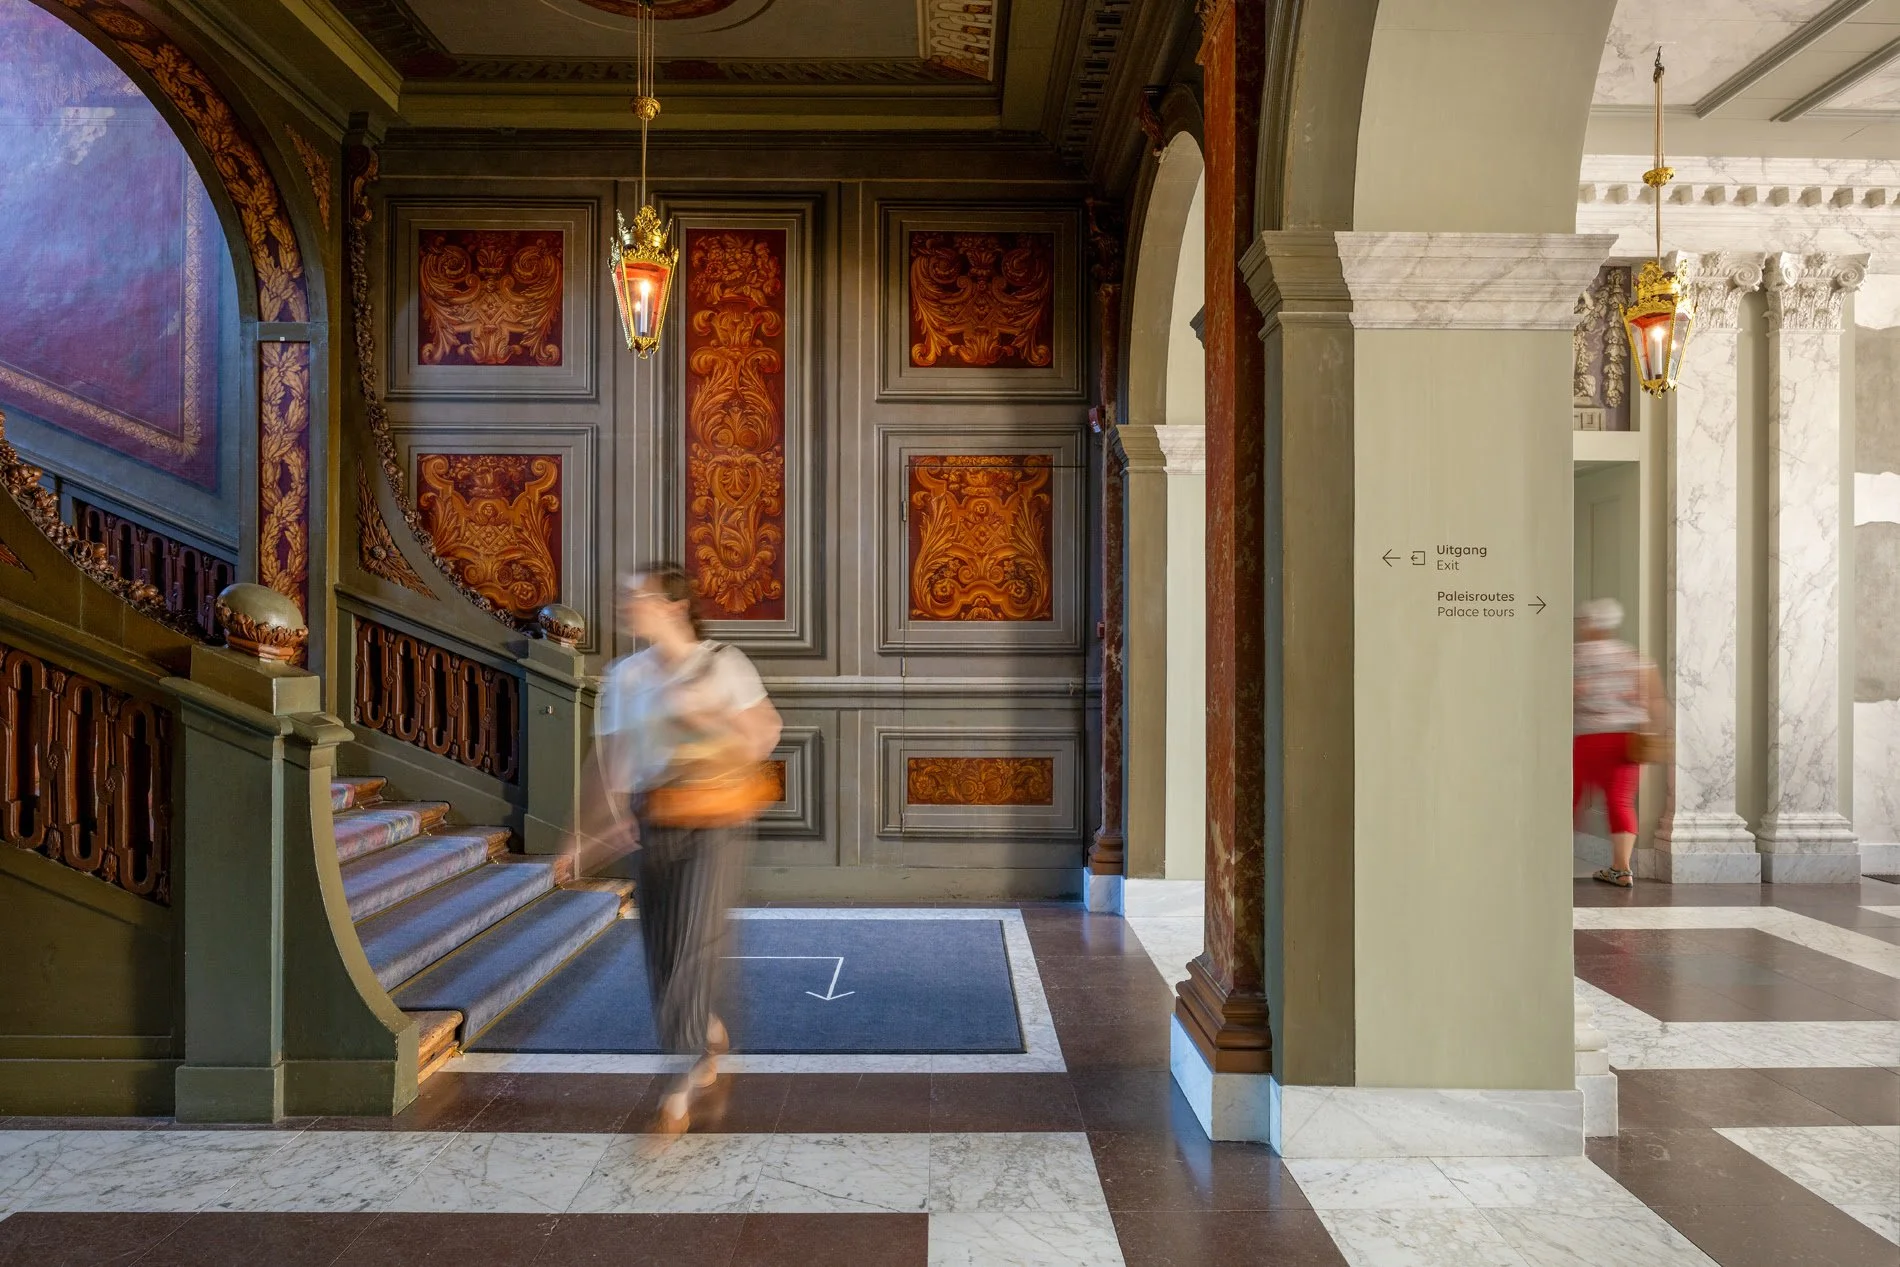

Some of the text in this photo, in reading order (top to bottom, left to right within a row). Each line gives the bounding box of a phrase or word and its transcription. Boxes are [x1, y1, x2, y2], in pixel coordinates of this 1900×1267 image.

[1436, 545, 1488, 558] Uitgang
[1436, 560, 1460, 571] Exit
[1437, 591, 1515, 602] Paleisroutes
[1437, 606, 1515, 617] Palace tours
